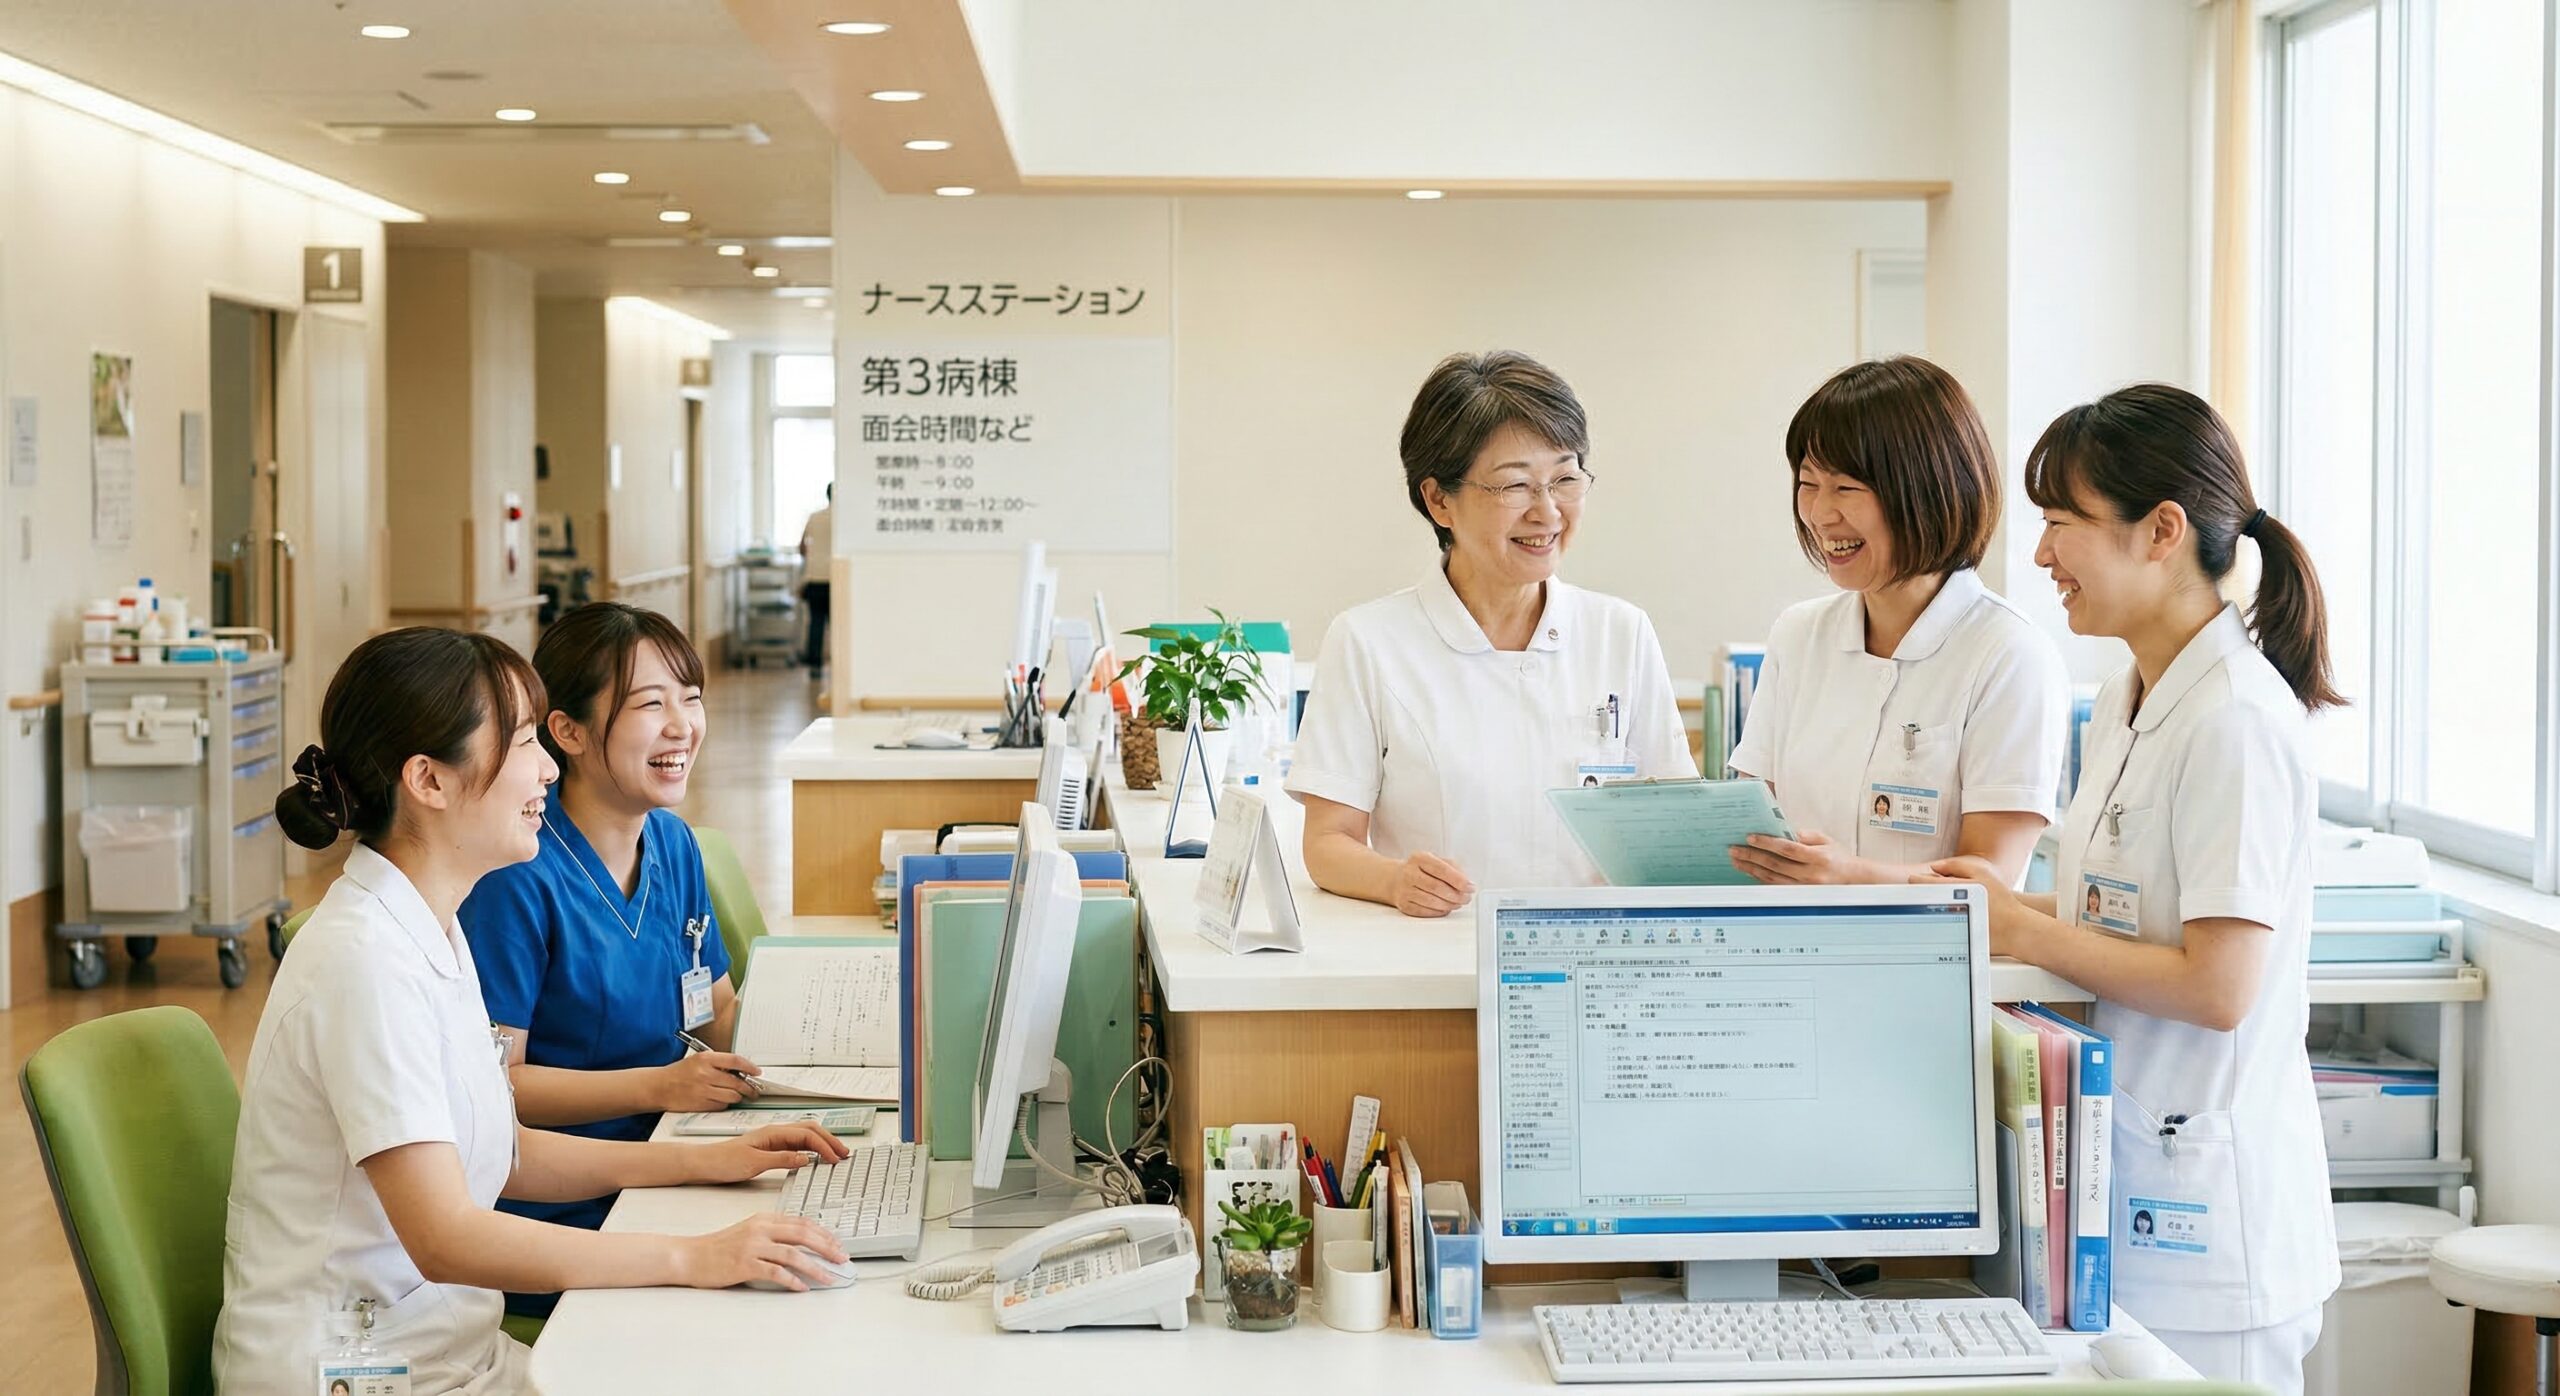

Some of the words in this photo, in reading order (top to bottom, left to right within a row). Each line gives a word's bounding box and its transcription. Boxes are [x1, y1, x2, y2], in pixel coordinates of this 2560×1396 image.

[321, 250, 340, 289] 1
[862, 282, 1145, 317] ナースステーション
[861, 355, 1018, 398] 第3病棟
[861, 414, 1034, 444] 面会時間など
